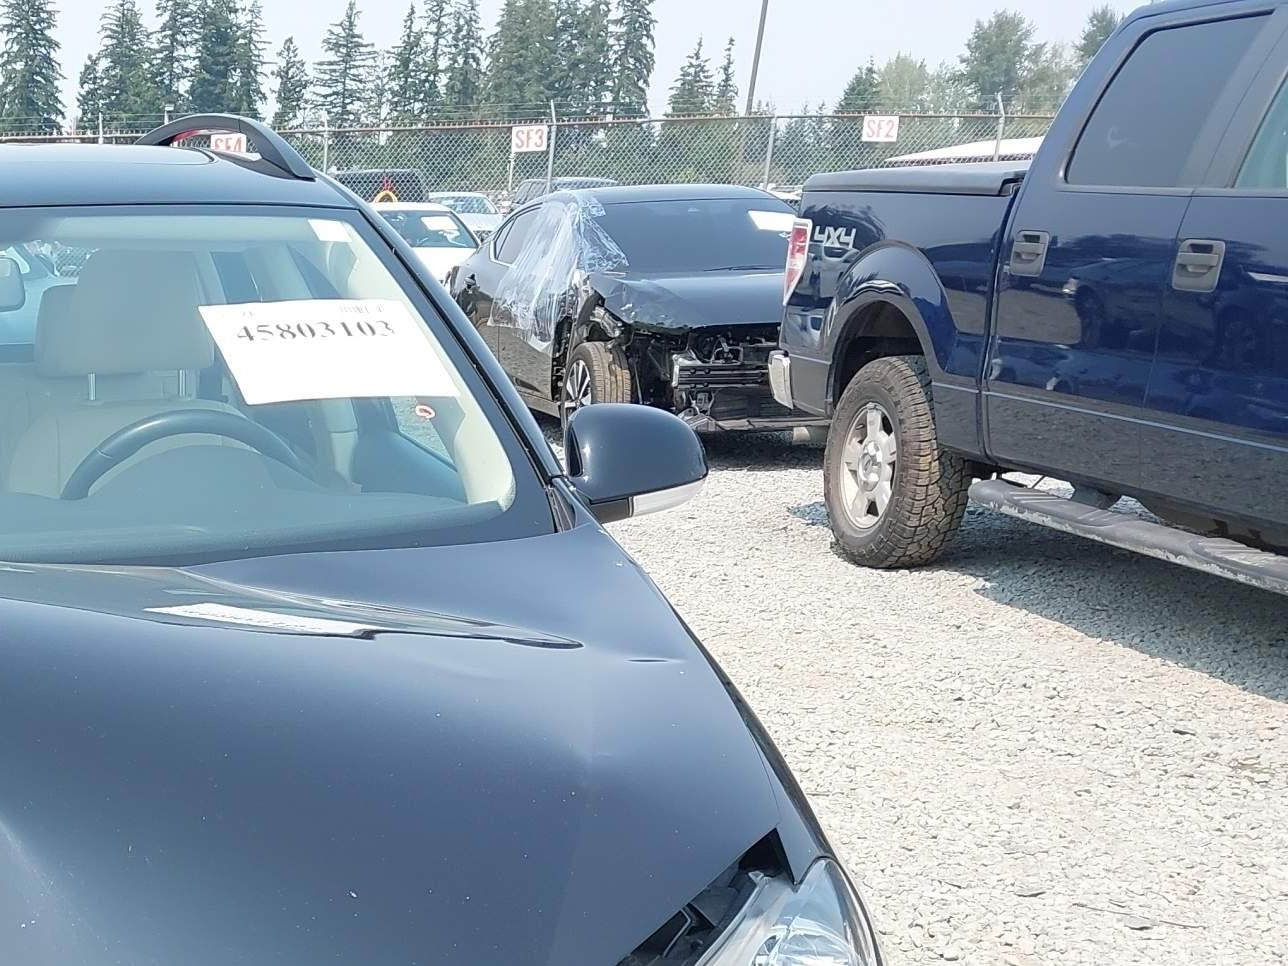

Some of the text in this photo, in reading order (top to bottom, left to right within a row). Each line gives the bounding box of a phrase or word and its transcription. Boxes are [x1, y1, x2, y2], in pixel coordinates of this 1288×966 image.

[515, 128, 544, 149] SF3
[866, 119, 895, 138] SF2
[237, 320, 396, 342] 45803103
